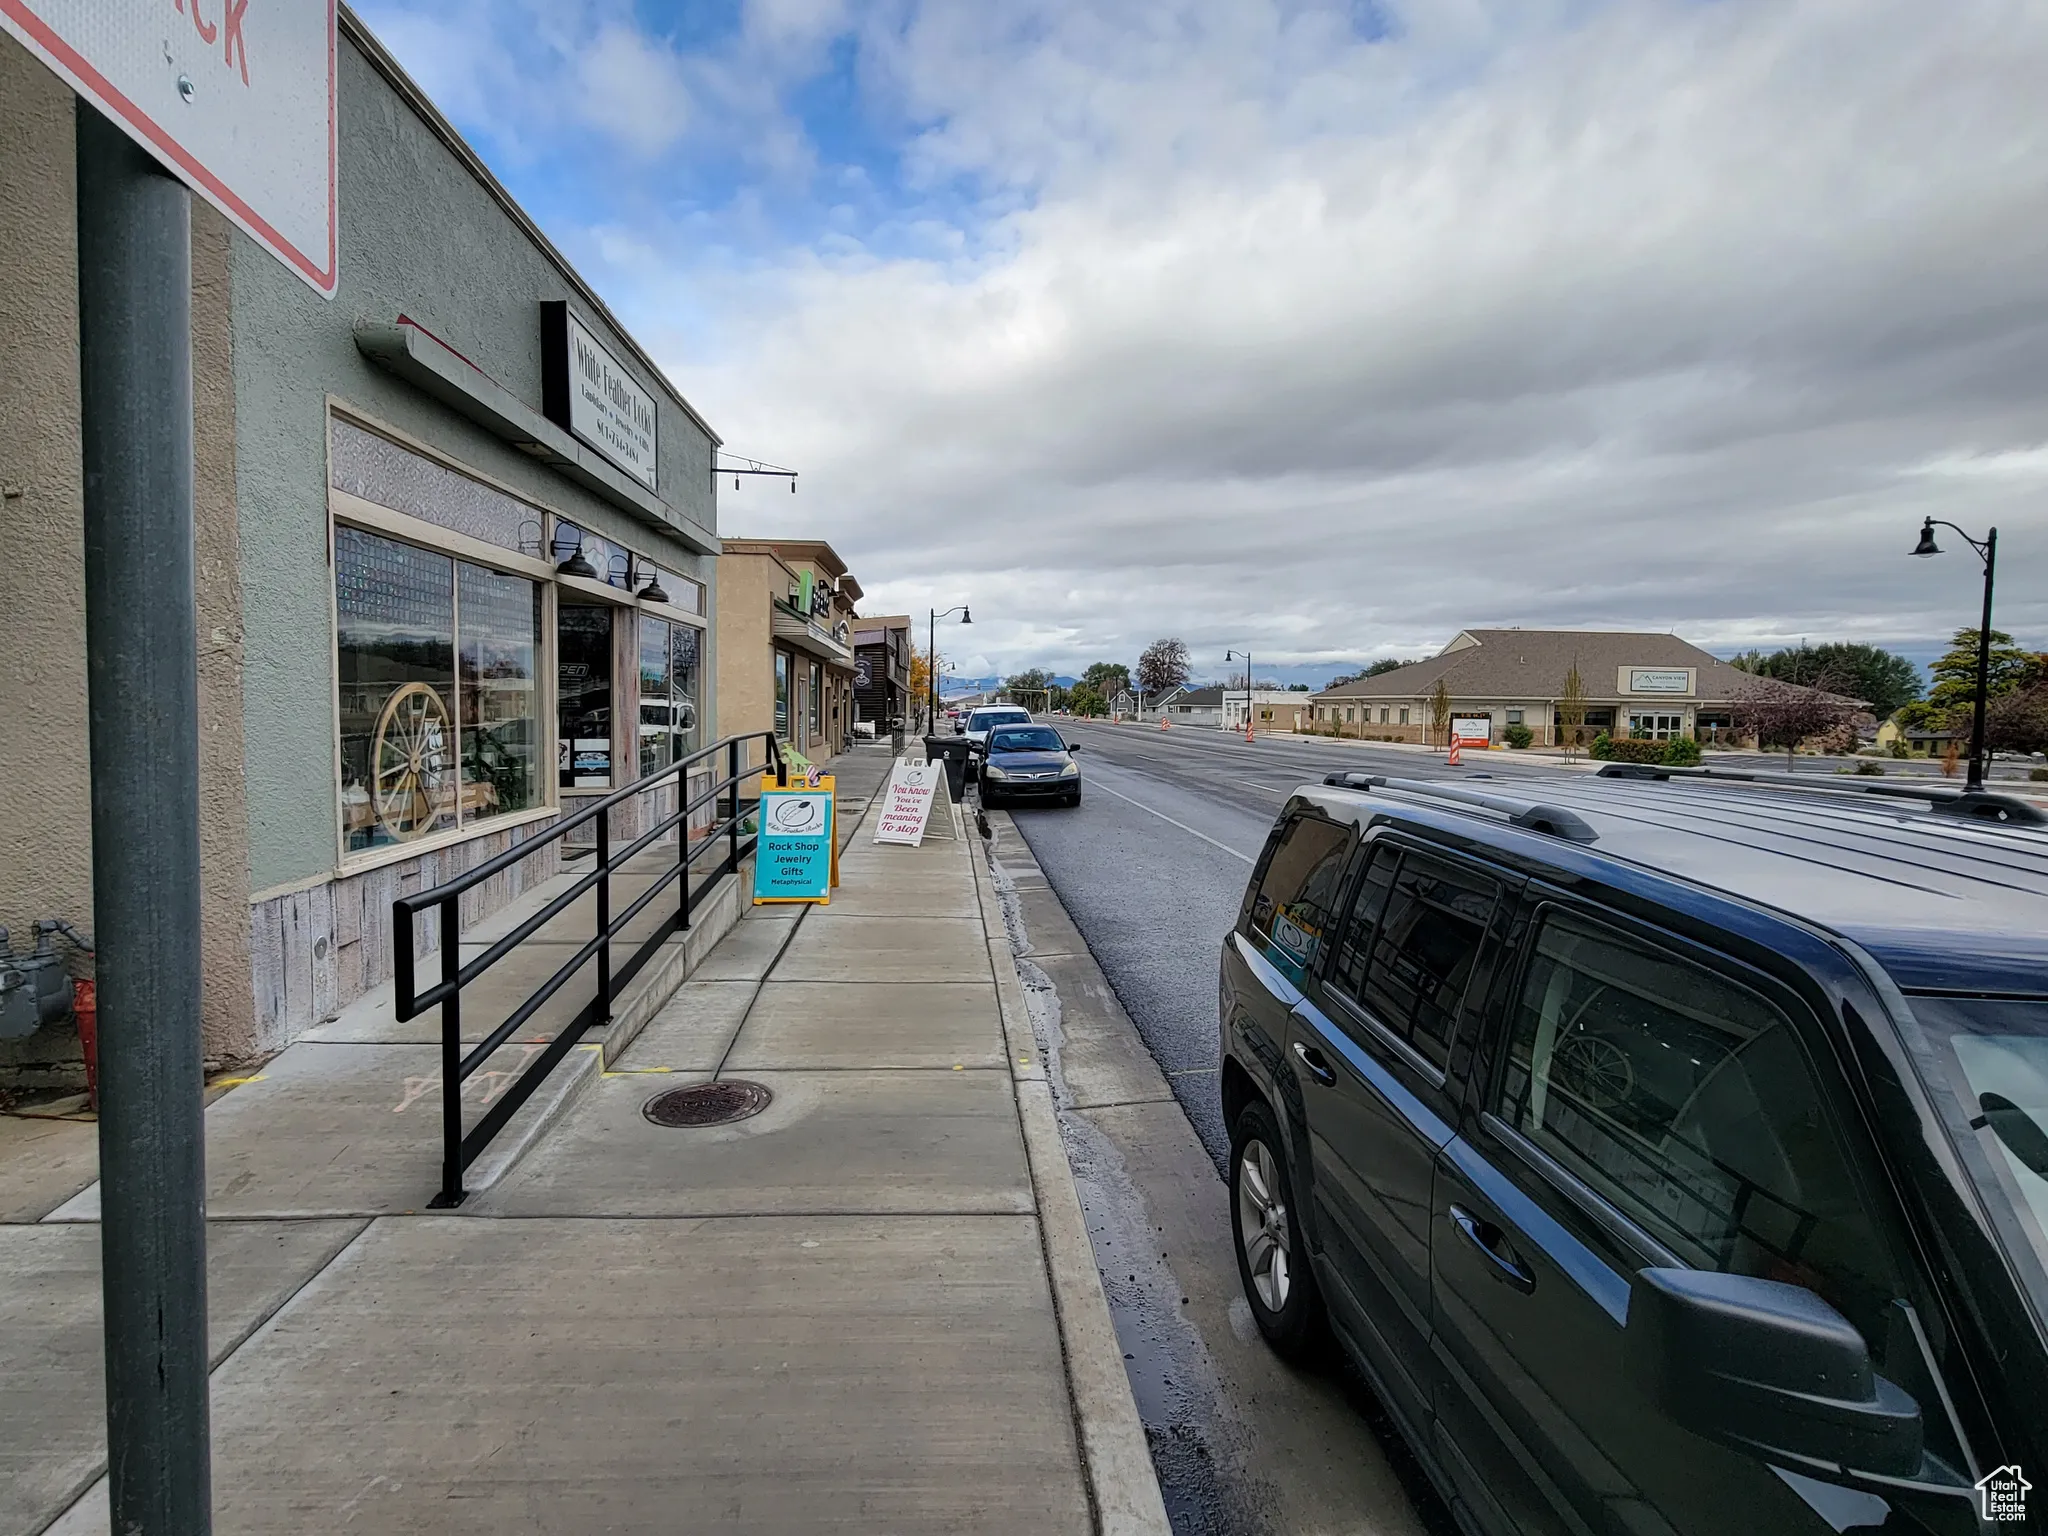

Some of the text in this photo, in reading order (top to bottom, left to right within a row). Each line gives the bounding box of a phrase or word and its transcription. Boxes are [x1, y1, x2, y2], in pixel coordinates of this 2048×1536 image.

[576, 337, 601, 389] White
[603, 364, 631, 417] Feather
[581, 383, 607, 416] Lapidary
[892, 783, 907, 794] You
[908, 787, 931, 796] know
[894, 795, 922, 803] You've
[893, 804, 919, 813] Been
[884, 813, 923, 824] meaning
[881, 821, 919, 835] To stop
[768, 842, 819, 852] Rock Shop
[774, 854, 812, 864] Jewelry
[781, 867, 804, 876] Gifts
